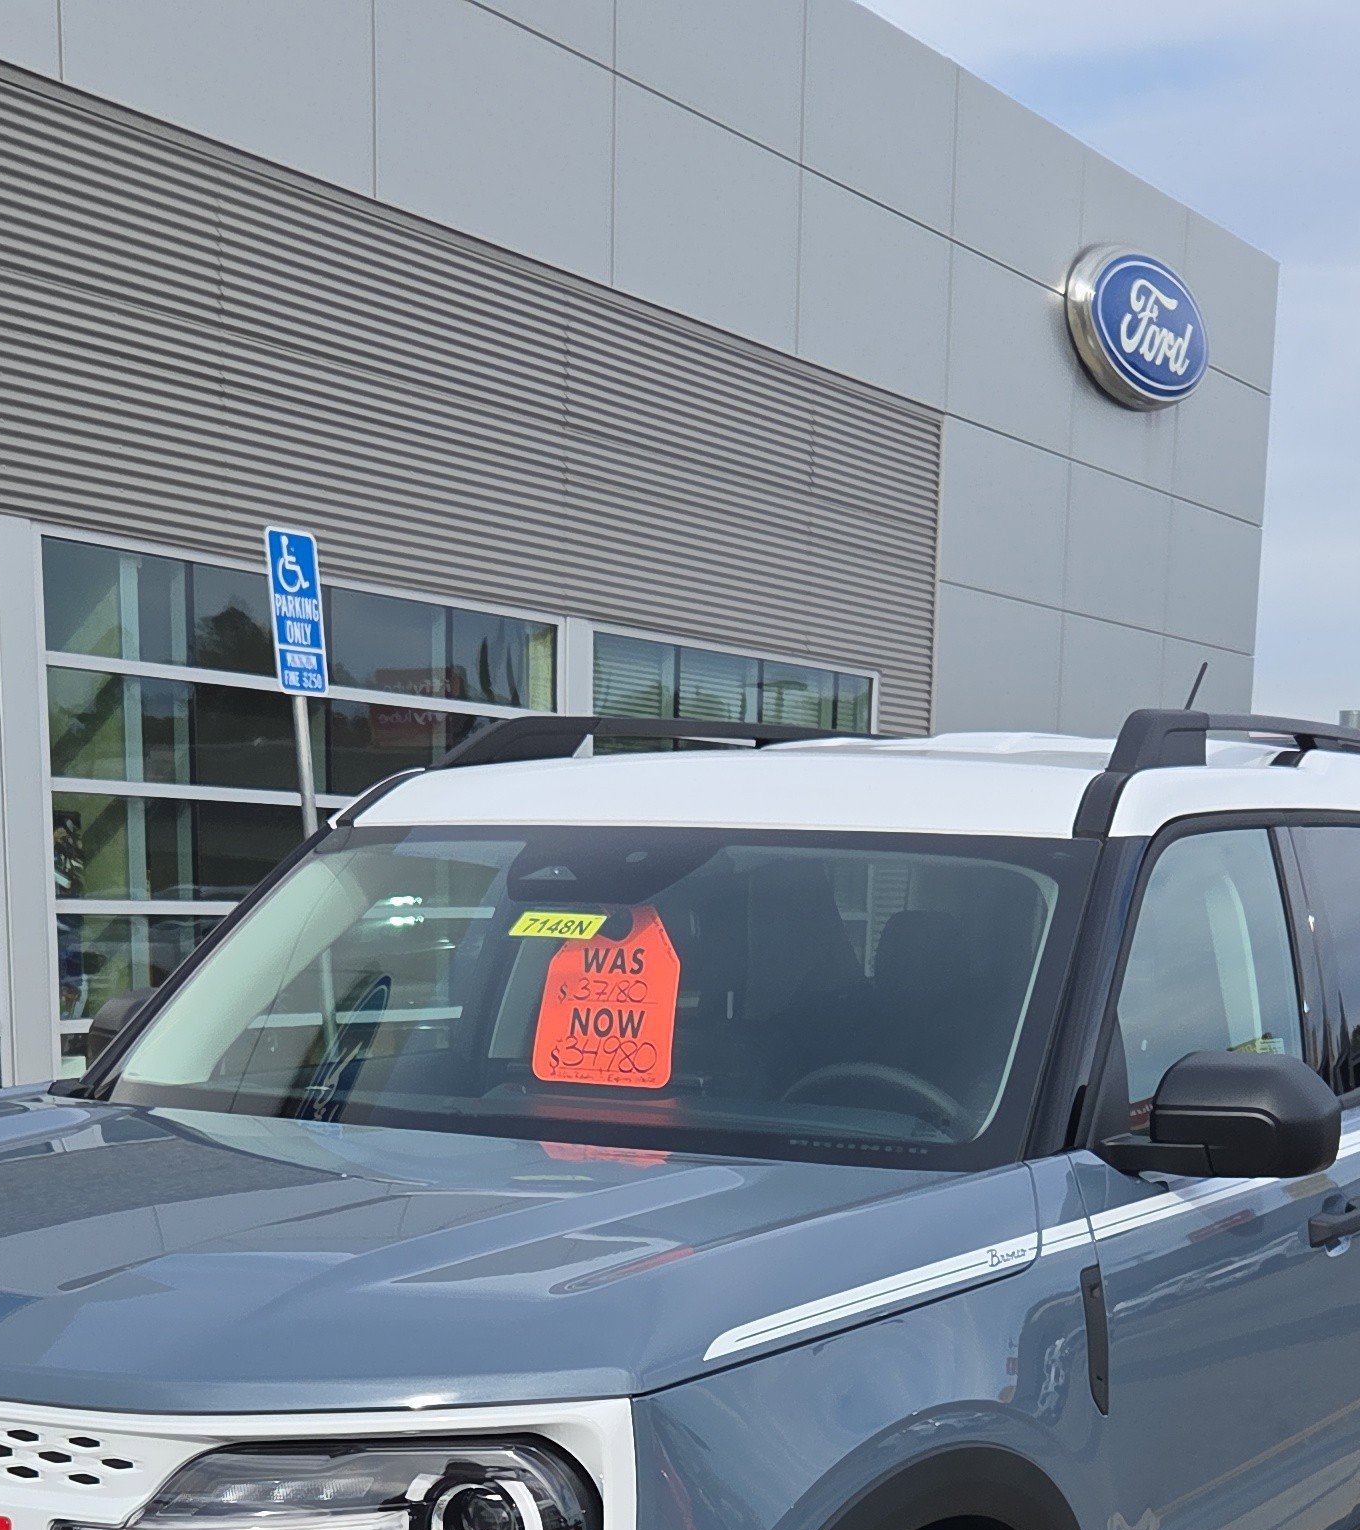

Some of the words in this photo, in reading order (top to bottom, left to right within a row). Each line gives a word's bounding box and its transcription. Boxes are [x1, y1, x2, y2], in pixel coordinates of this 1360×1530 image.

[1120, 278, 1193, 376] Ford
[274, 593, 320, 621] PARKING
[285, 620, 312, 645] ONLY
[523, 917, 592, 936] 7148N
[583, 947, 645, 975] WAS
[570, 1006, 646, 1038] NOW
[987, 1248, 1027, 1267] Bronco
